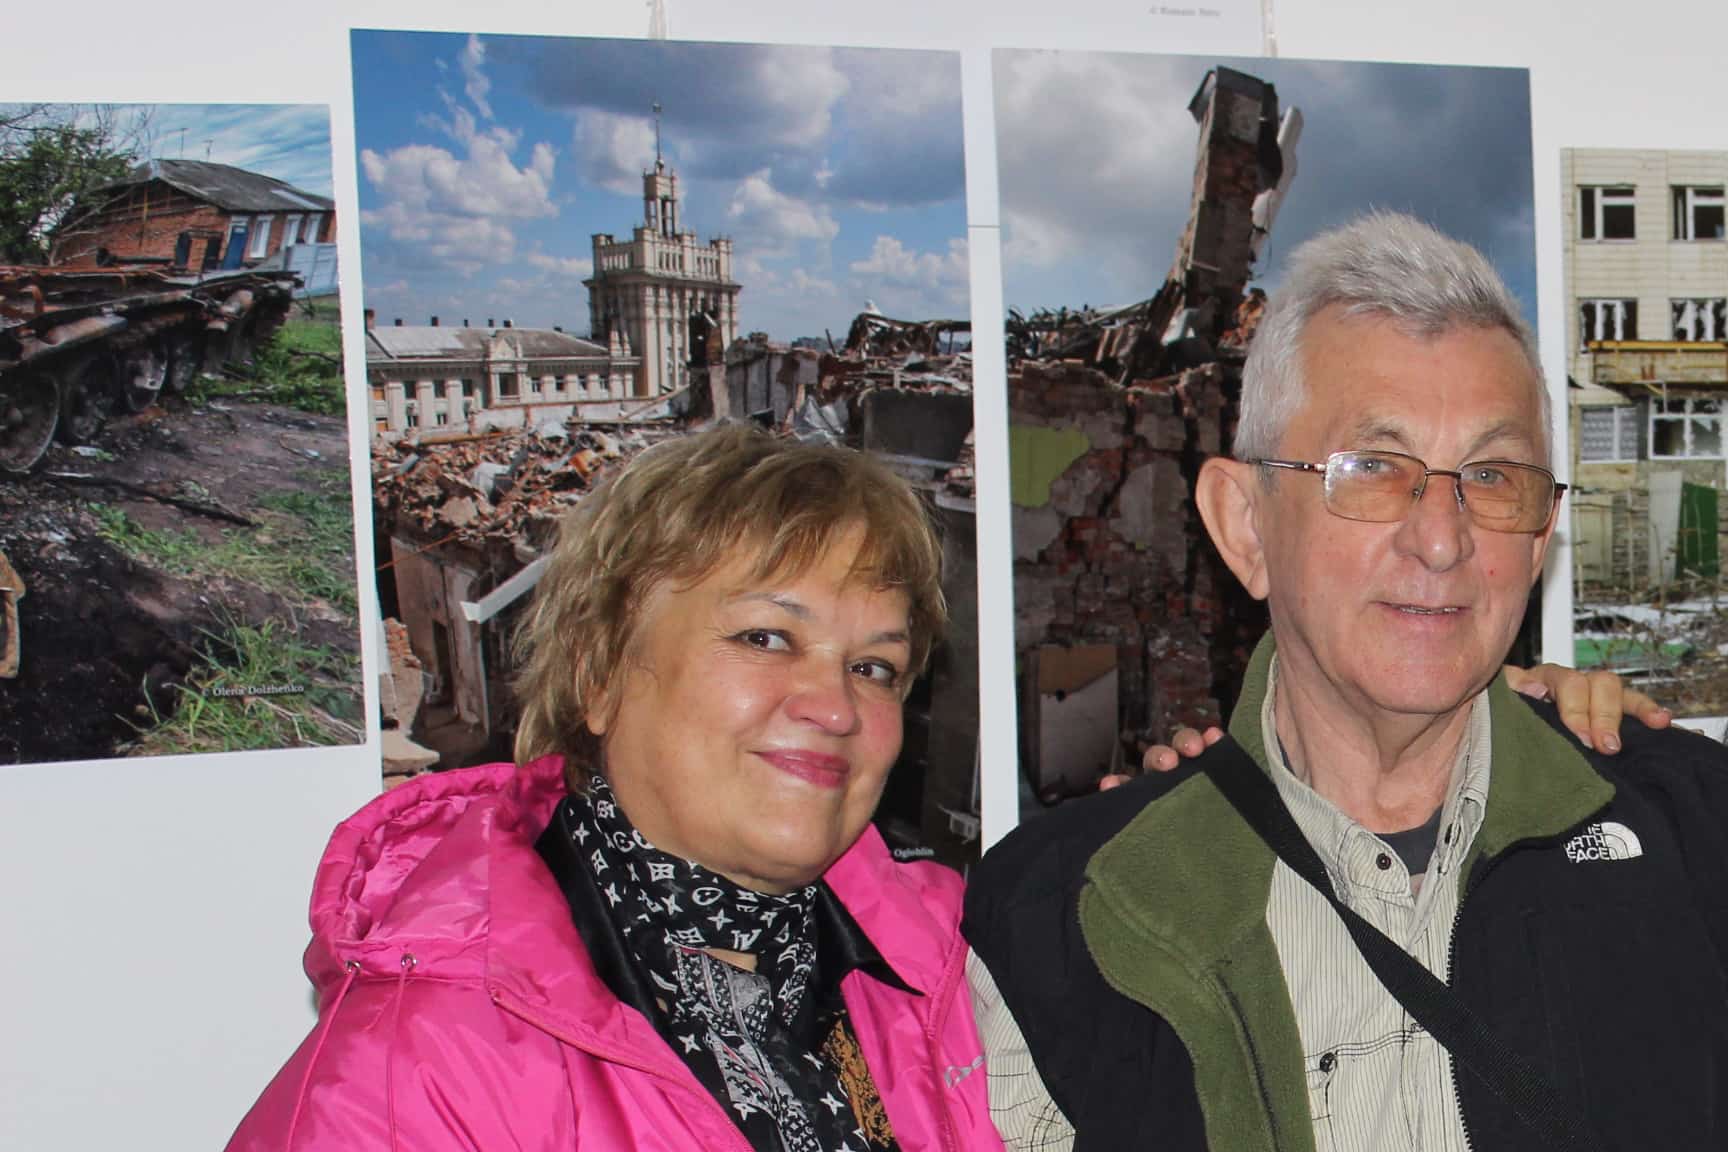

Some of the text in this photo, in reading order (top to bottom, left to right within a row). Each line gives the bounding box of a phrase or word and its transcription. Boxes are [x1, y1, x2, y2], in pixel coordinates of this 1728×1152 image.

[212, 687, 245, 697] Olena
[1563, 835, 1606, 850] RTH
[1566, 847, 1610, 863] FACE
